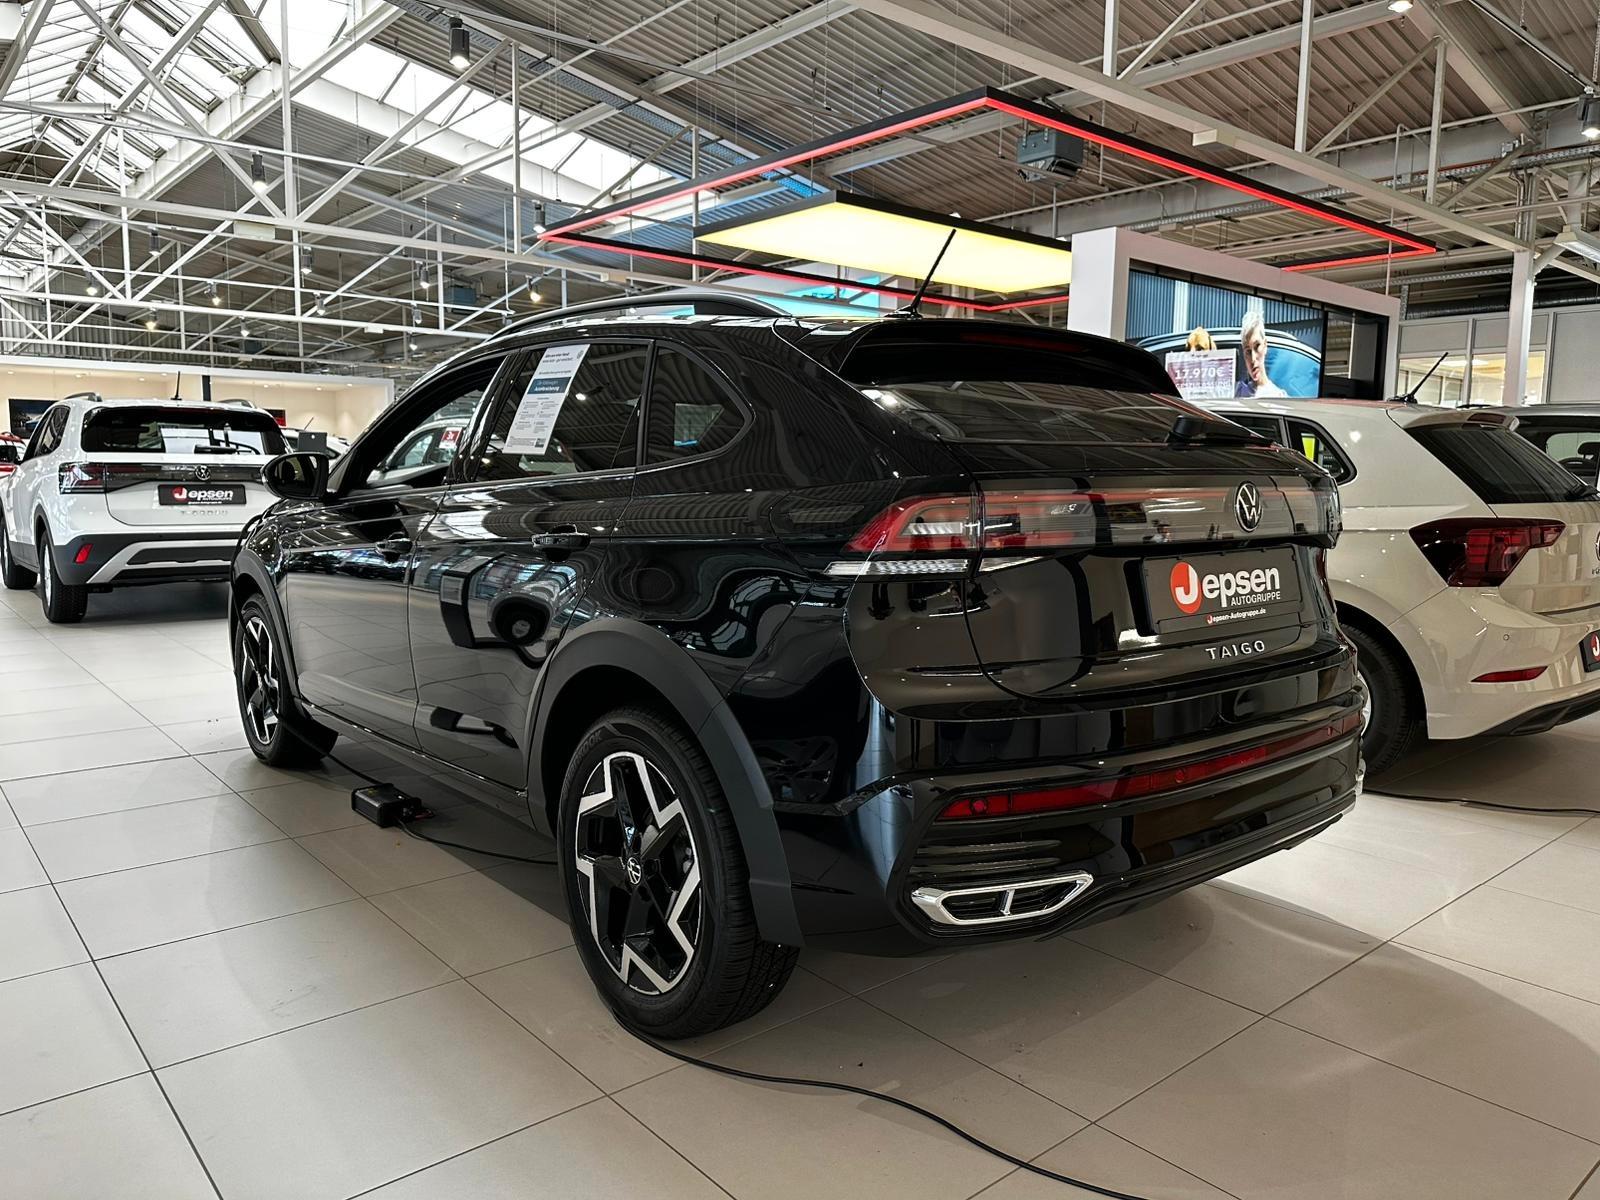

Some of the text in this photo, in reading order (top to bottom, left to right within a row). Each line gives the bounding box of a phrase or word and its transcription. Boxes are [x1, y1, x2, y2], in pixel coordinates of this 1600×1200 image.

[173, 486, 233, 500] Jepsen
[1173, 563, 1281, 608] Jepsen
[1230, 591, 1281, 606] AUTOGRUPPE
[1205, 640, 1265, 660] TAIGO
